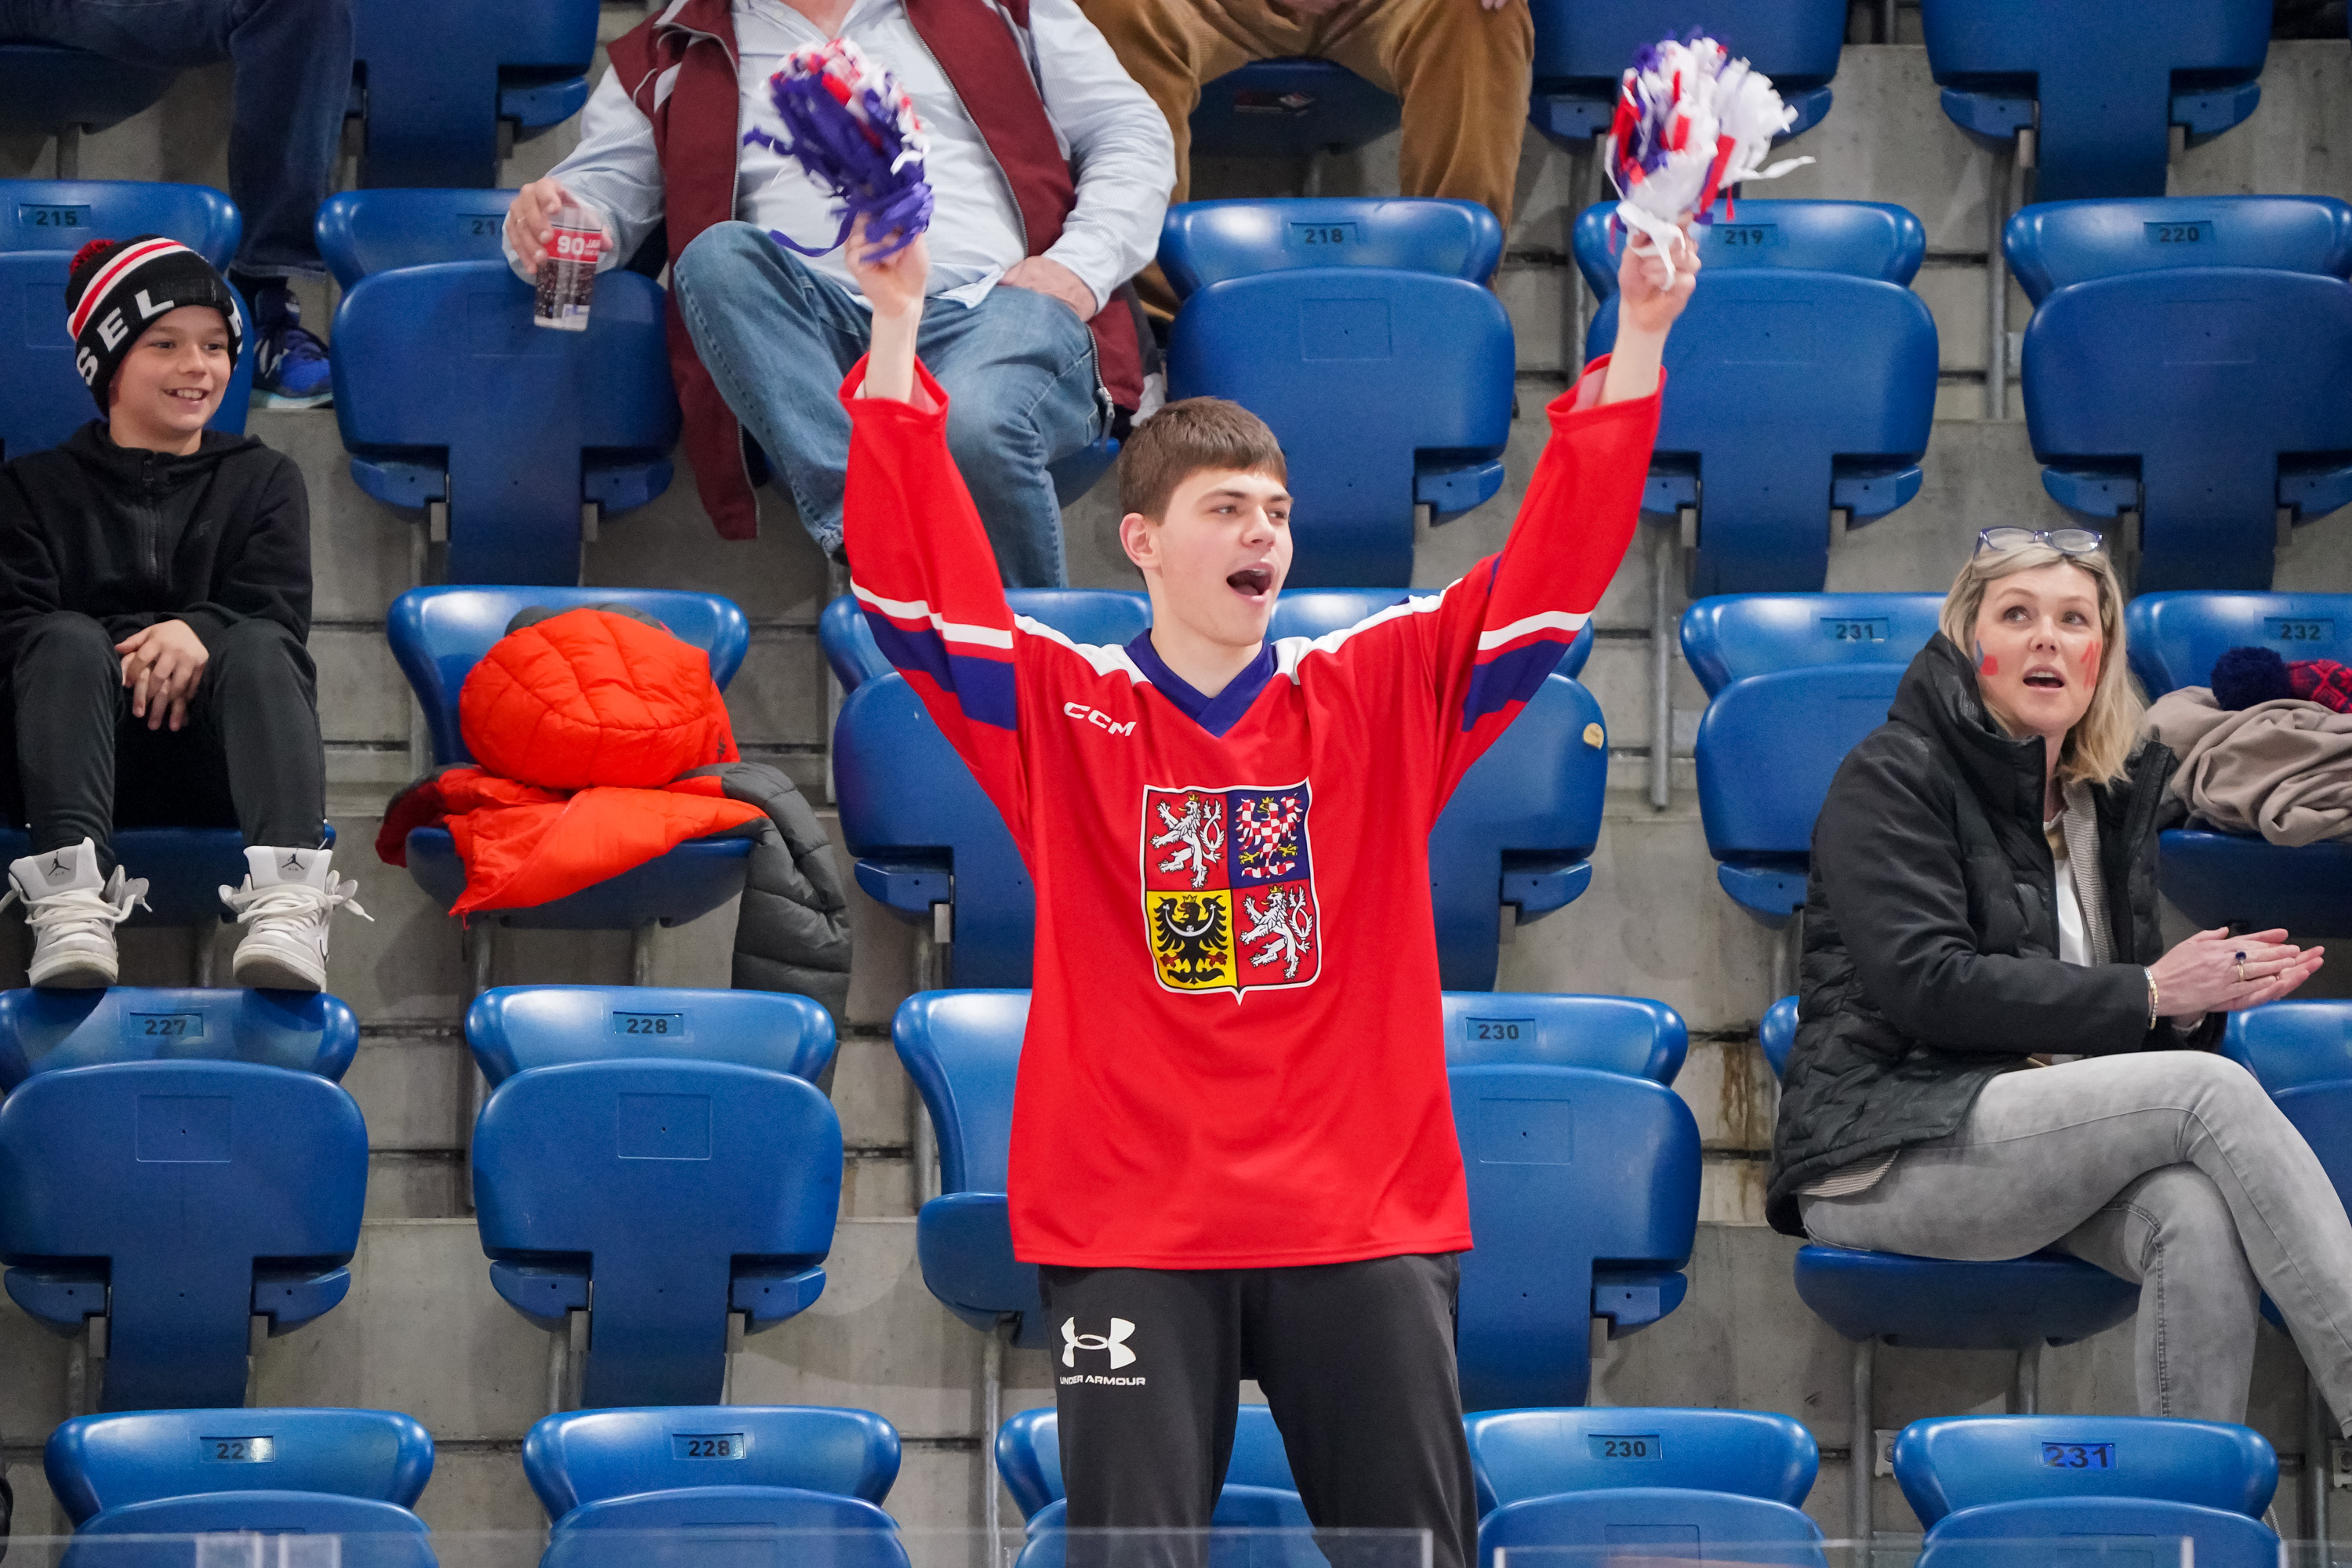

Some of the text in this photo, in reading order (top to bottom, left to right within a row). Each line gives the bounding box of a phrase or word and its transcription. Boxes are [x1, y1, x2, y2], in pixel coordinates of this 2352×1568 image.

[36, 210, 77, 227] 215
[472, 220, 503, 234] 21
[1305, 228, 1343, 244] 218
[1725, 229, 1763, 244] 219
[2159, 227, 2200, 243] 220
[557, 235, 586, 256] 90
[1836, 623, 1875, 640] 231
[2281, 623, 2321, 641] 232
[1063, 702, 1137, 737] CCM
[144, 1018, 187, 1036] 227
[626, 1018, 668, 1035] 228
[1479, 1024, 1519, 1040] 230
[1059, 1374, 1146, 1386] UNDER ARMOUR
[216, 1443, 252, 1460] 22
[688, 1440, 730, 1457] 228
[1604, 1440, 1646, 1457] 230
[2045, 1446, 2108, 1468] 231
